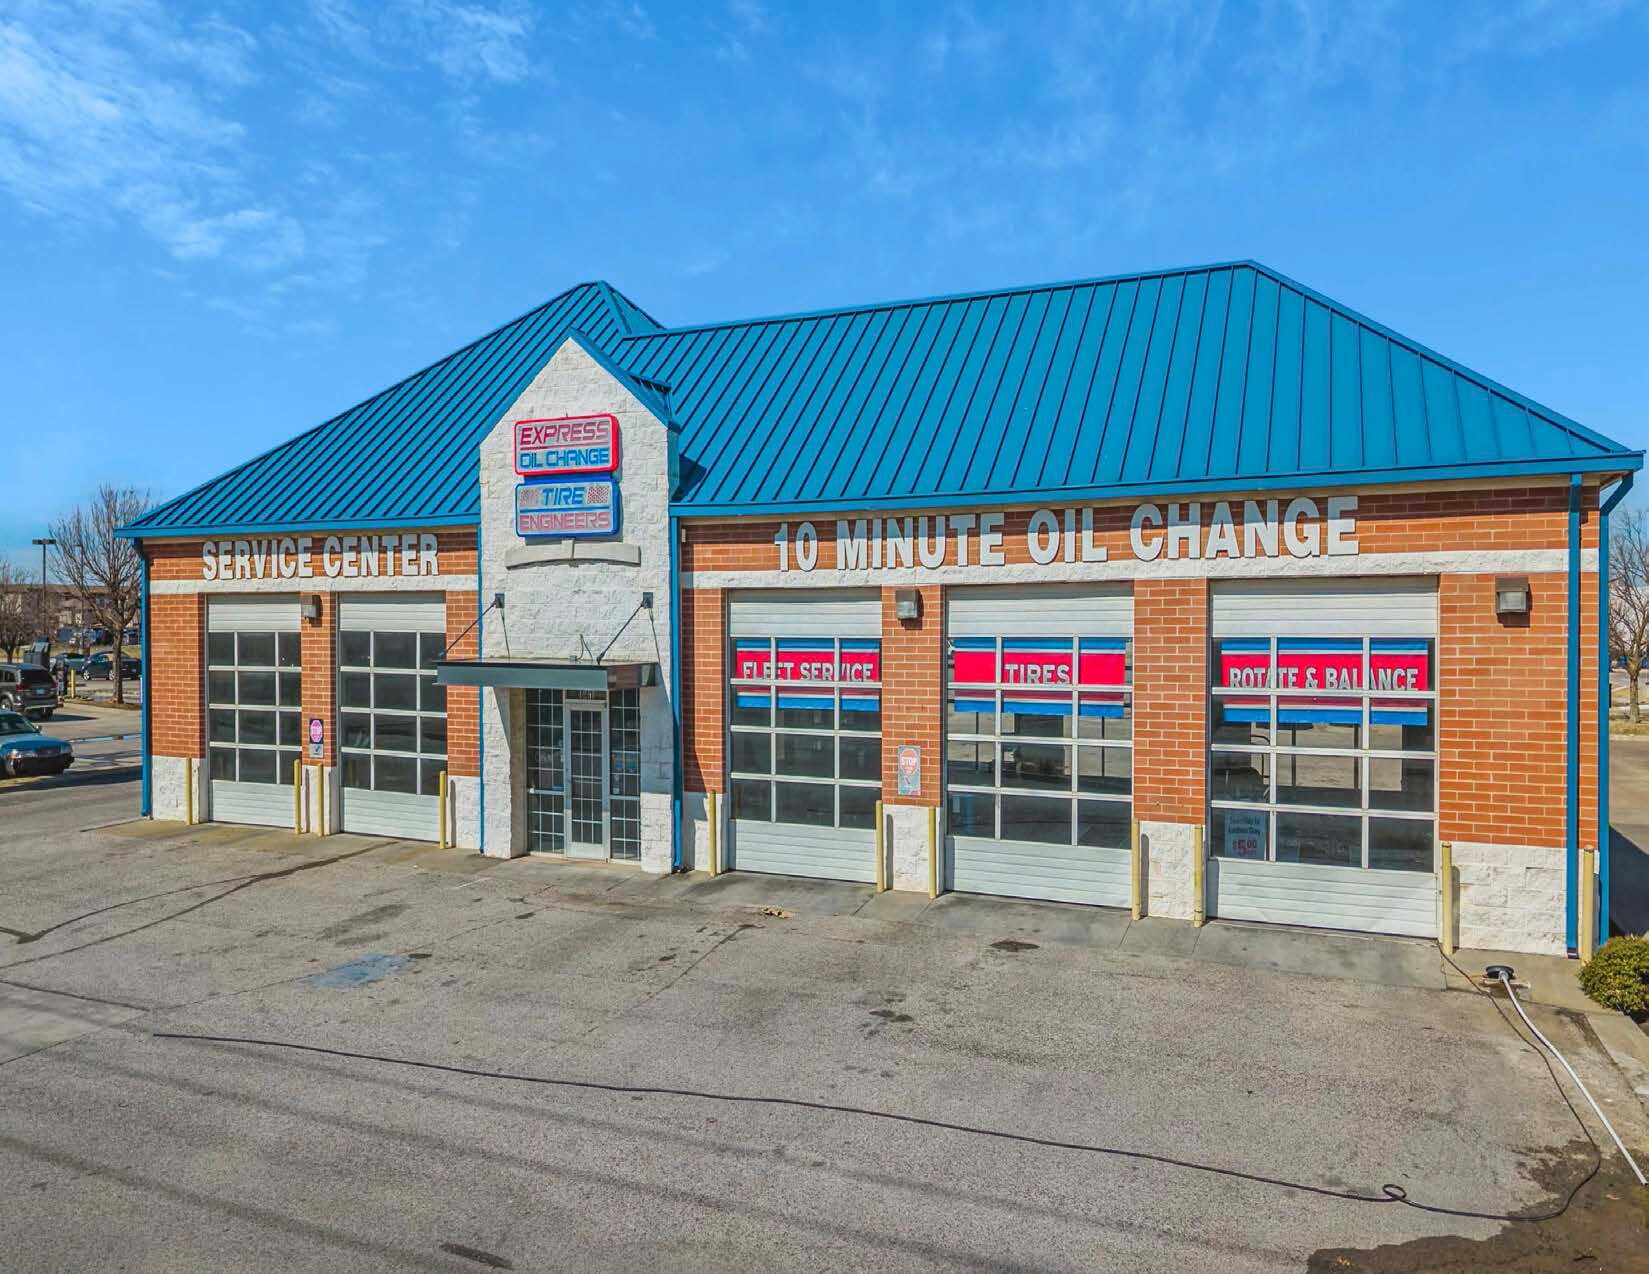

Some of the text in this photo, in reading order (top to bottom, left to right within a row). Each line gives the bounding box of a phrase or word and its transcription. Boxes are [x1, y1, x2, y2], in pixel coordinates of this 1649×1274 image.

[519, 421, 610, 446] EXPRESS
[519, 447, 610, 468] OIL CHANGE
[542, 486, 585, 506] TIRE
[519, 511, 610, 531] ENGINEERS
[774, 496, 1360, 572] 10 MINUTE OIL CHANGE
[202, 533, 439, 580] SERVICE CENTER
[1005, 664, 1070, 683] TIRES
[1305, 667, 1319, 689] &
